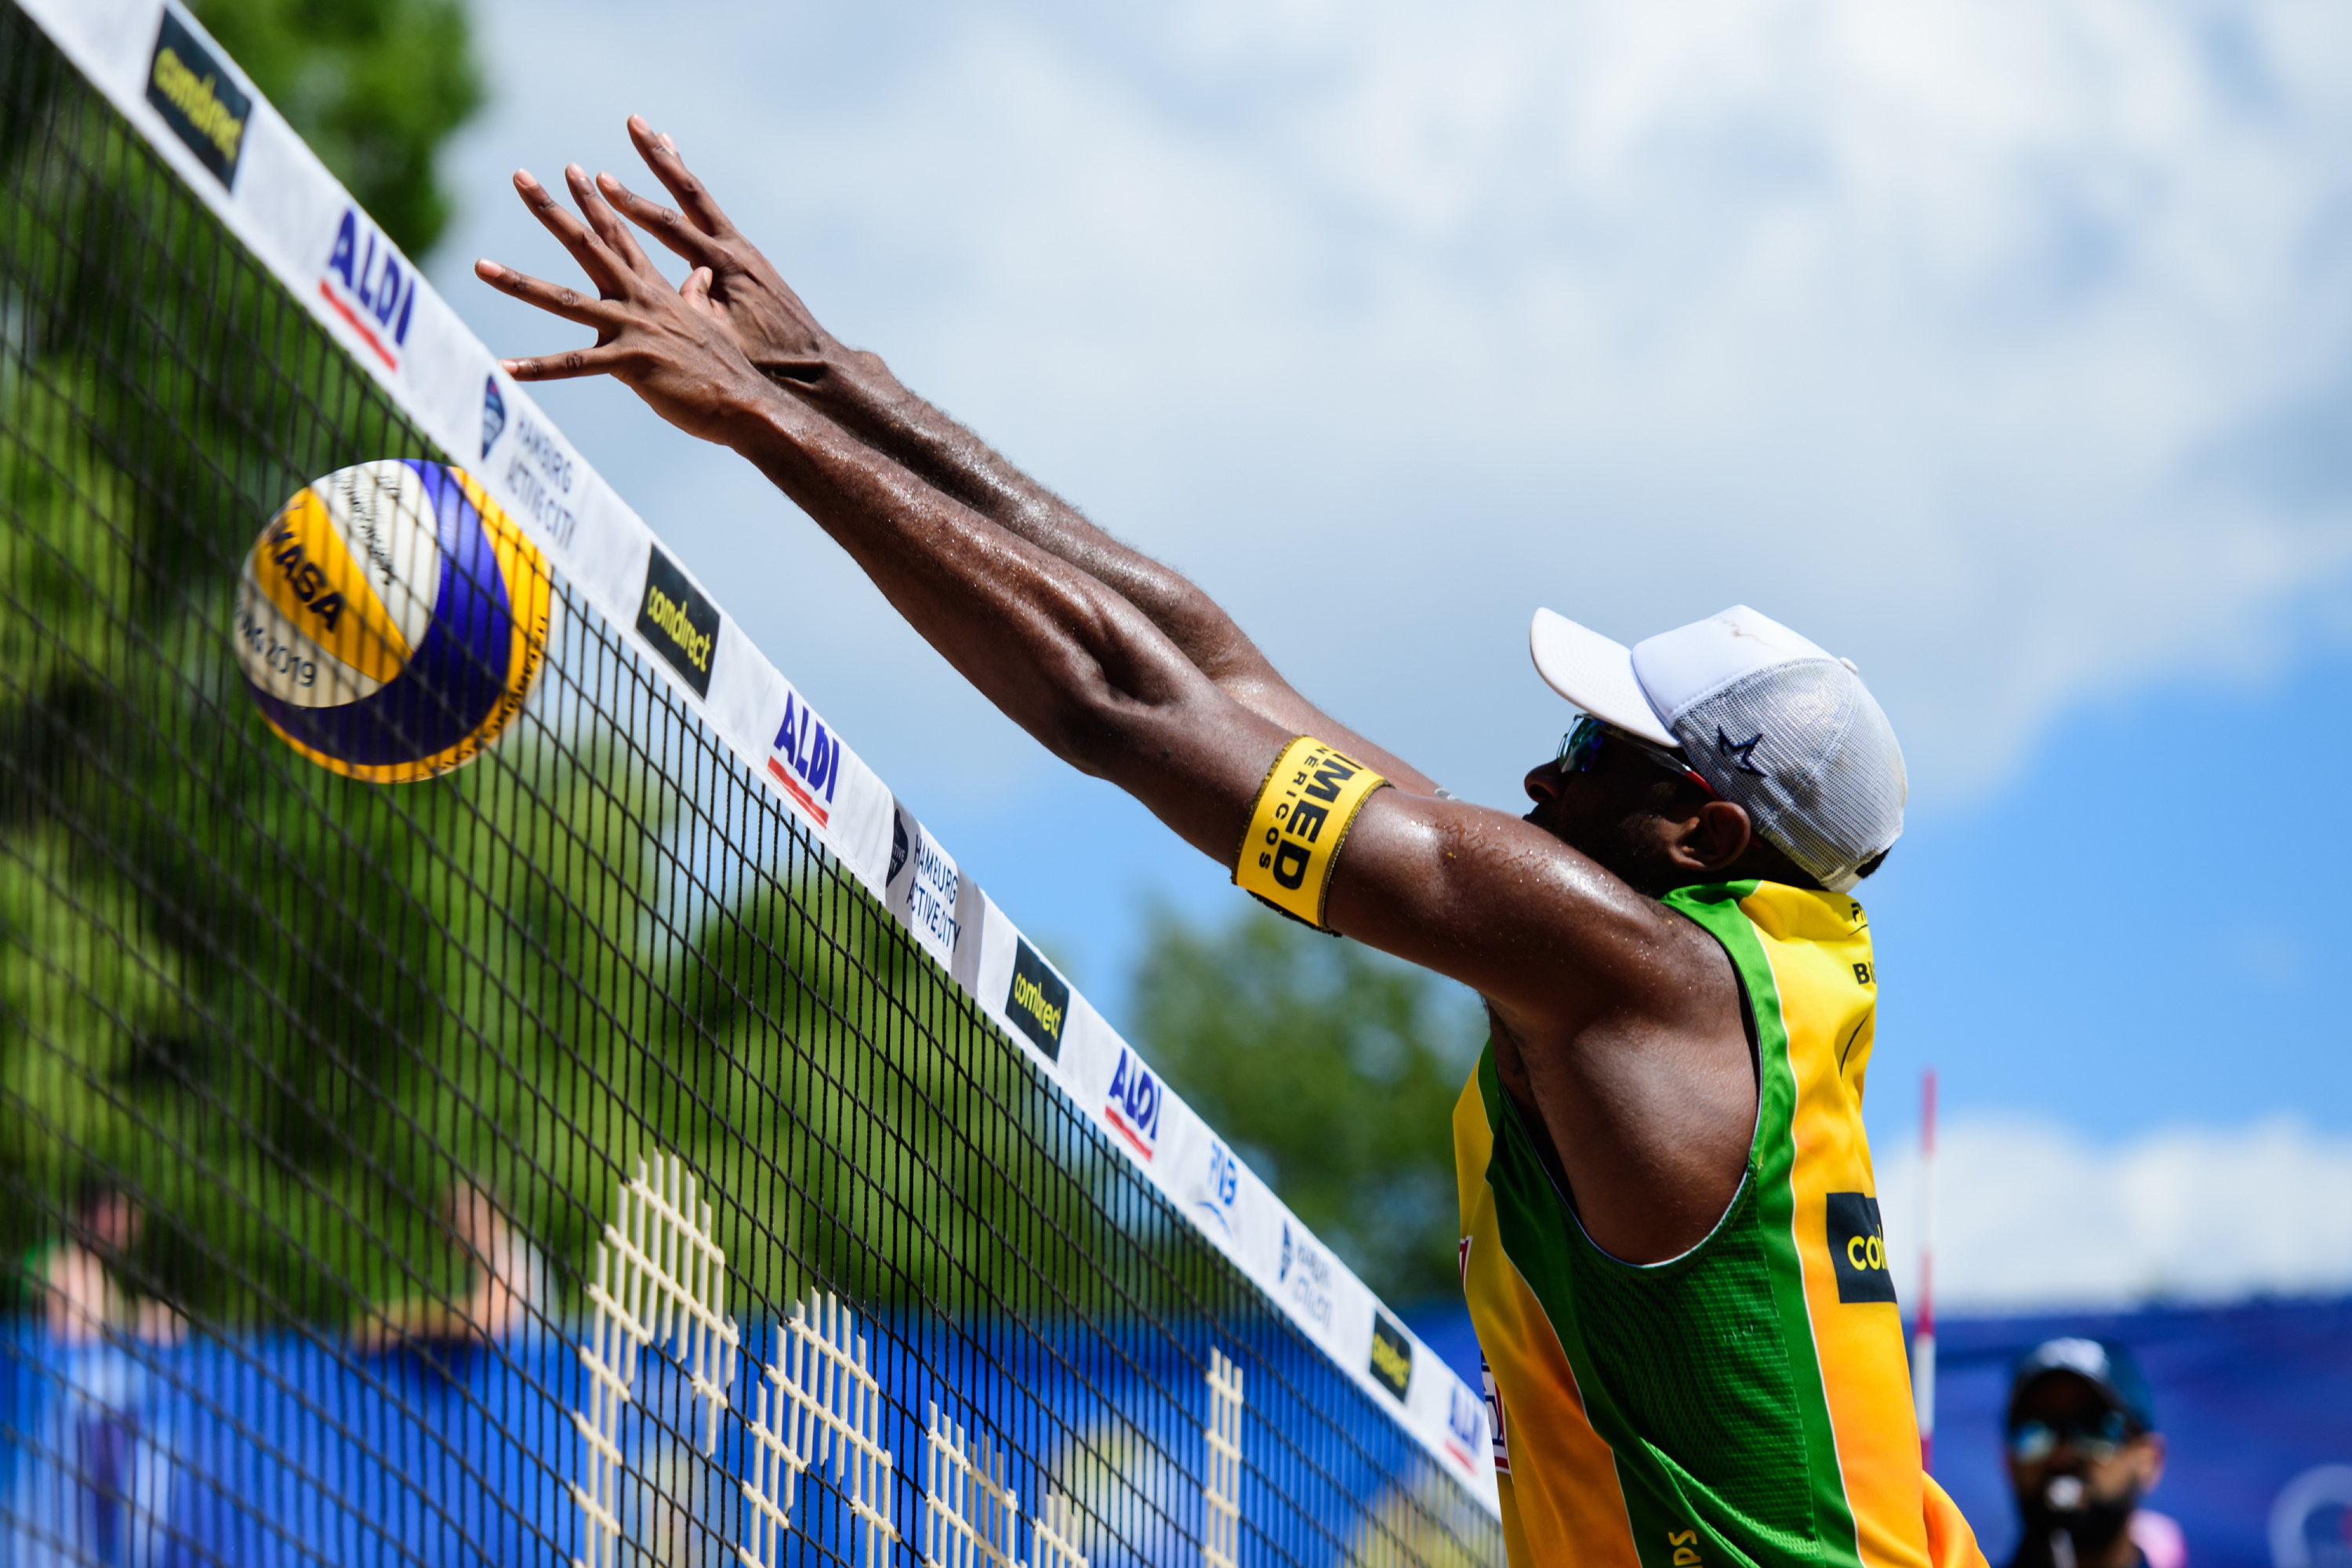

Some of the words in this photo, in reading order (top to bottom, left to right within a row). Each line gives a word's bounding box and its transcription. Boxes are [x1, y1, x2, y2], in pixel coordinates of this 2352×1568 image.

[329, 207, 416, 347] ALDI
[267, 643, 318, 688] 2019
[646, 585, 711, 673] comdirect
[773, 689, 840, 805] ALDI
[913, 833, 959, 905] HAMBURG
[906, 876, 941, 933] ACTIVE
[938, 909, 962, 953] CITY
[1108, 1046, 1163, 1142] ALDI
